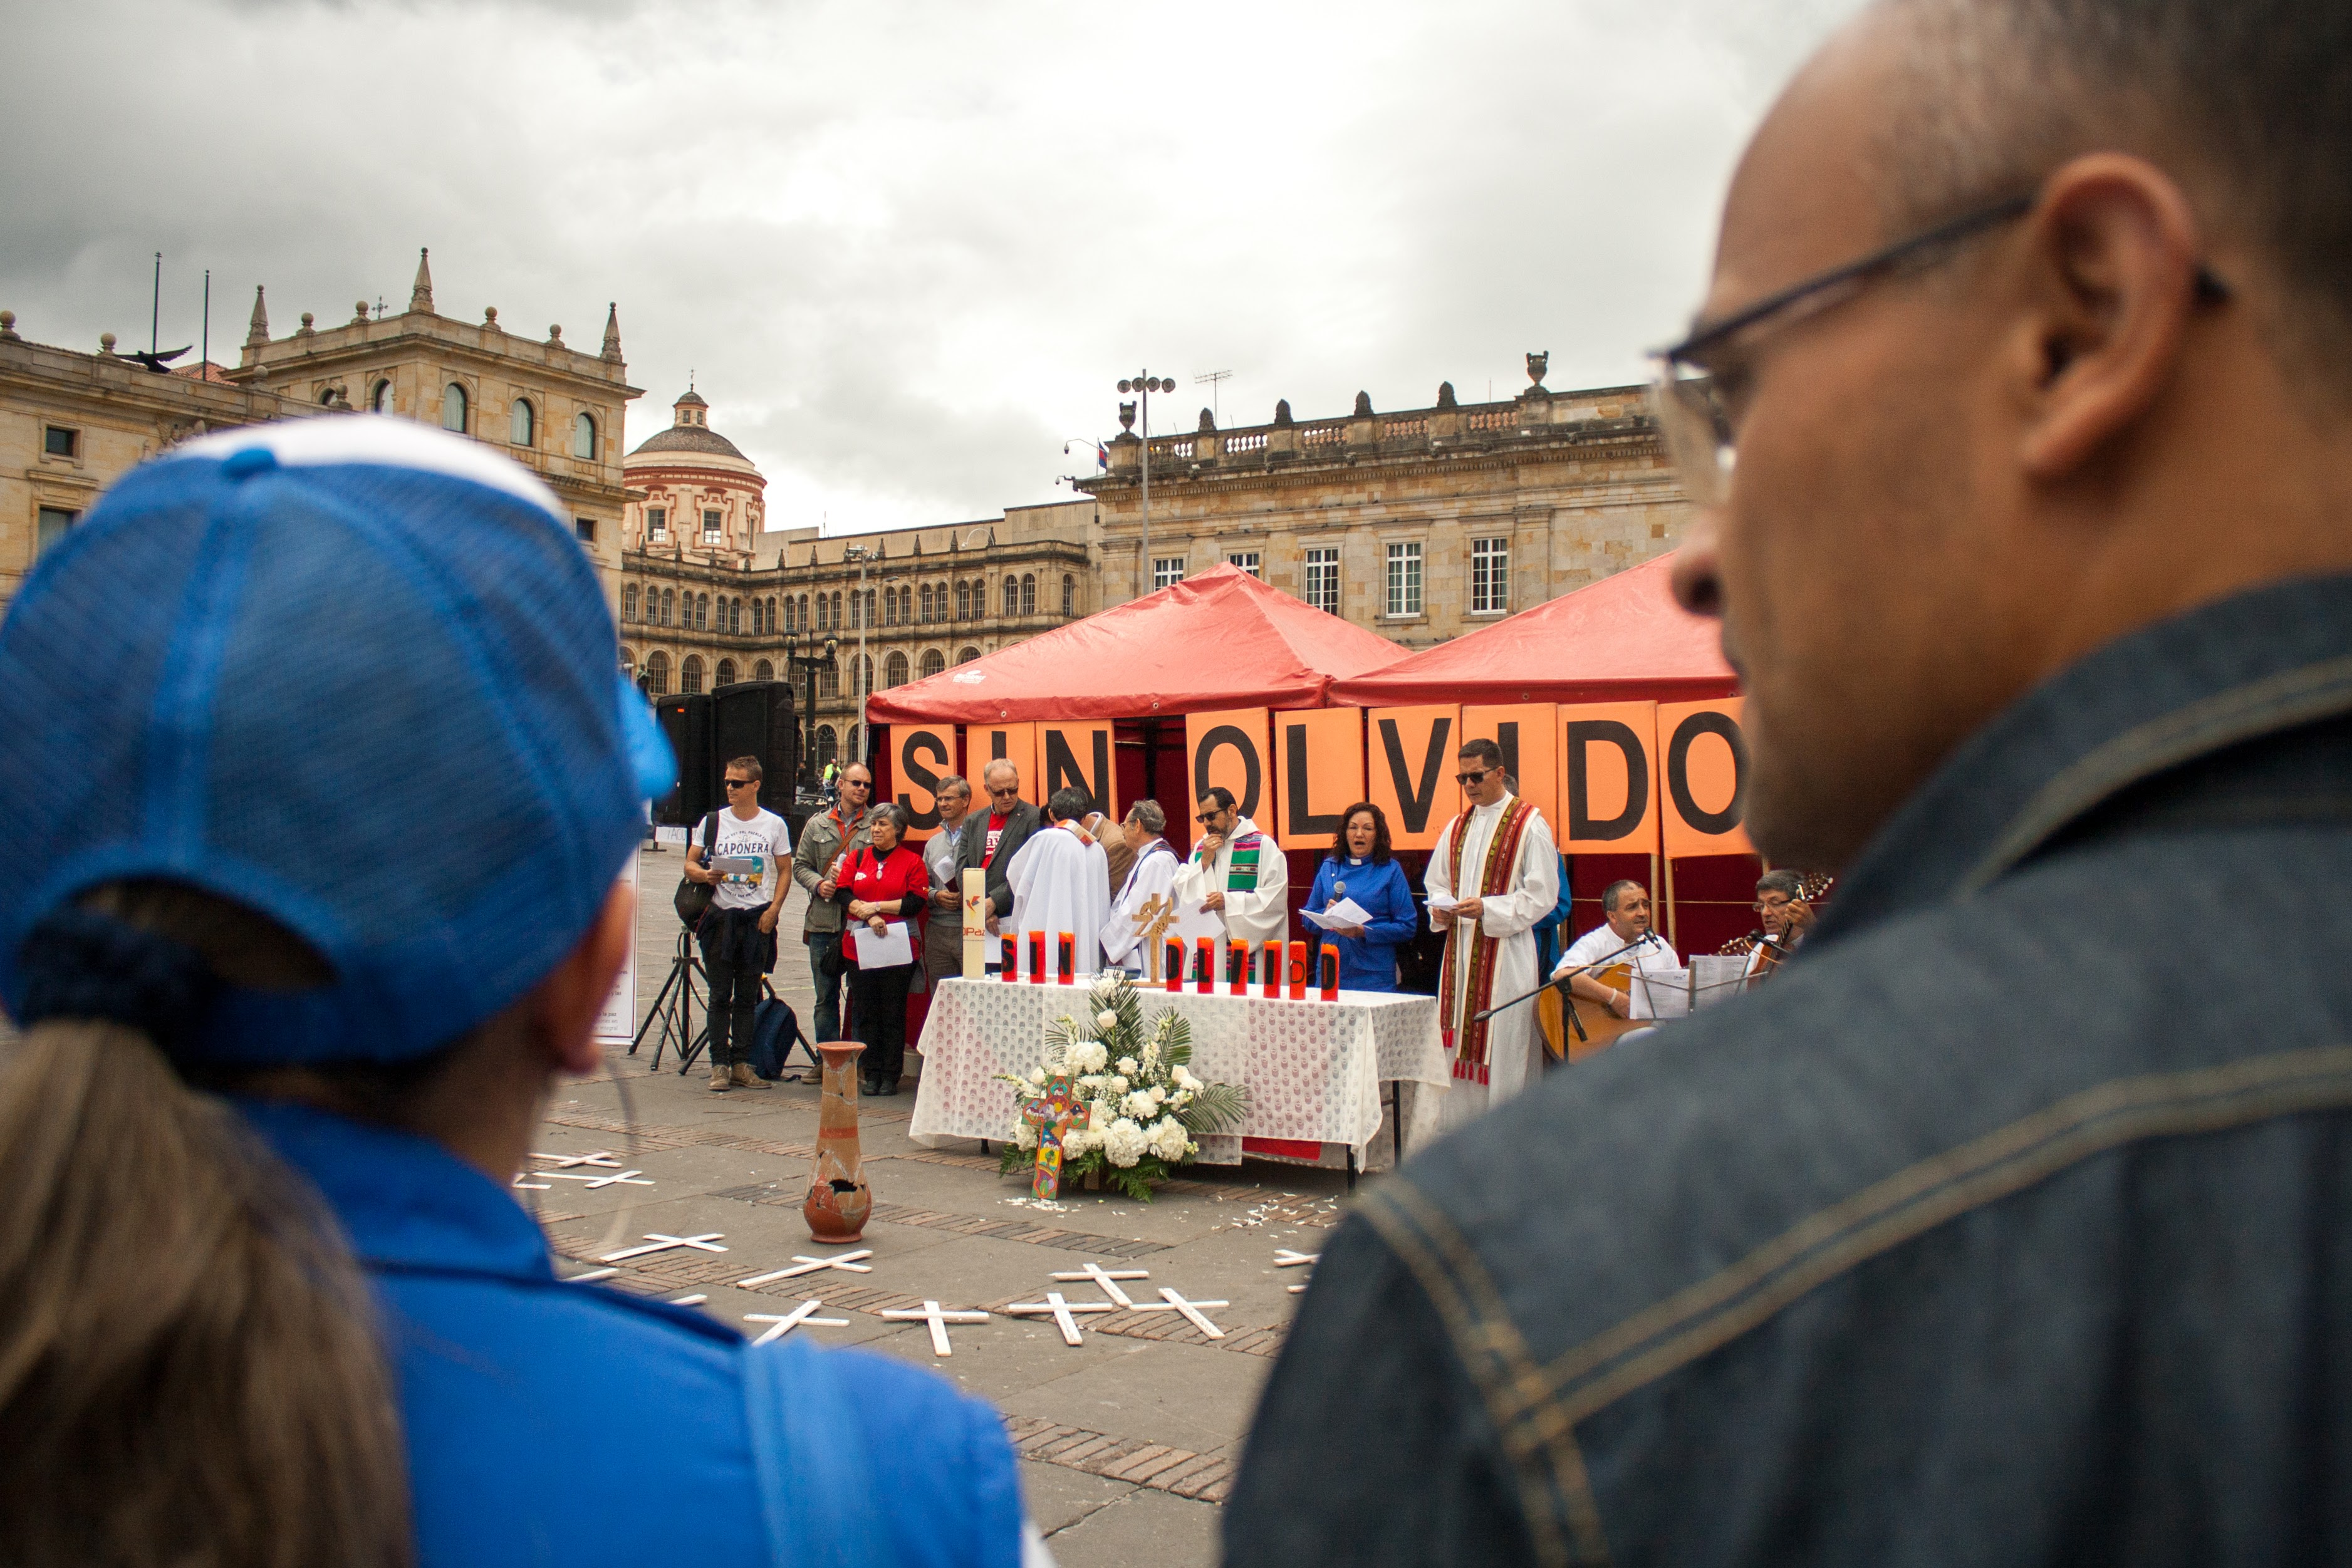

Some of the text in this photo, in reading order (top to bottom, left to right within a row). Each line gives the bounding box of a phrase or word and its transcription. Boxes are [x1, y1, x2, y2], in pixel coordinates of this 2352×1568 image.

[897, 730, 1108, 830] SN
[717, 843, 769, 856] CAPONERA
[1001, 938, 1071, 975] SIN
